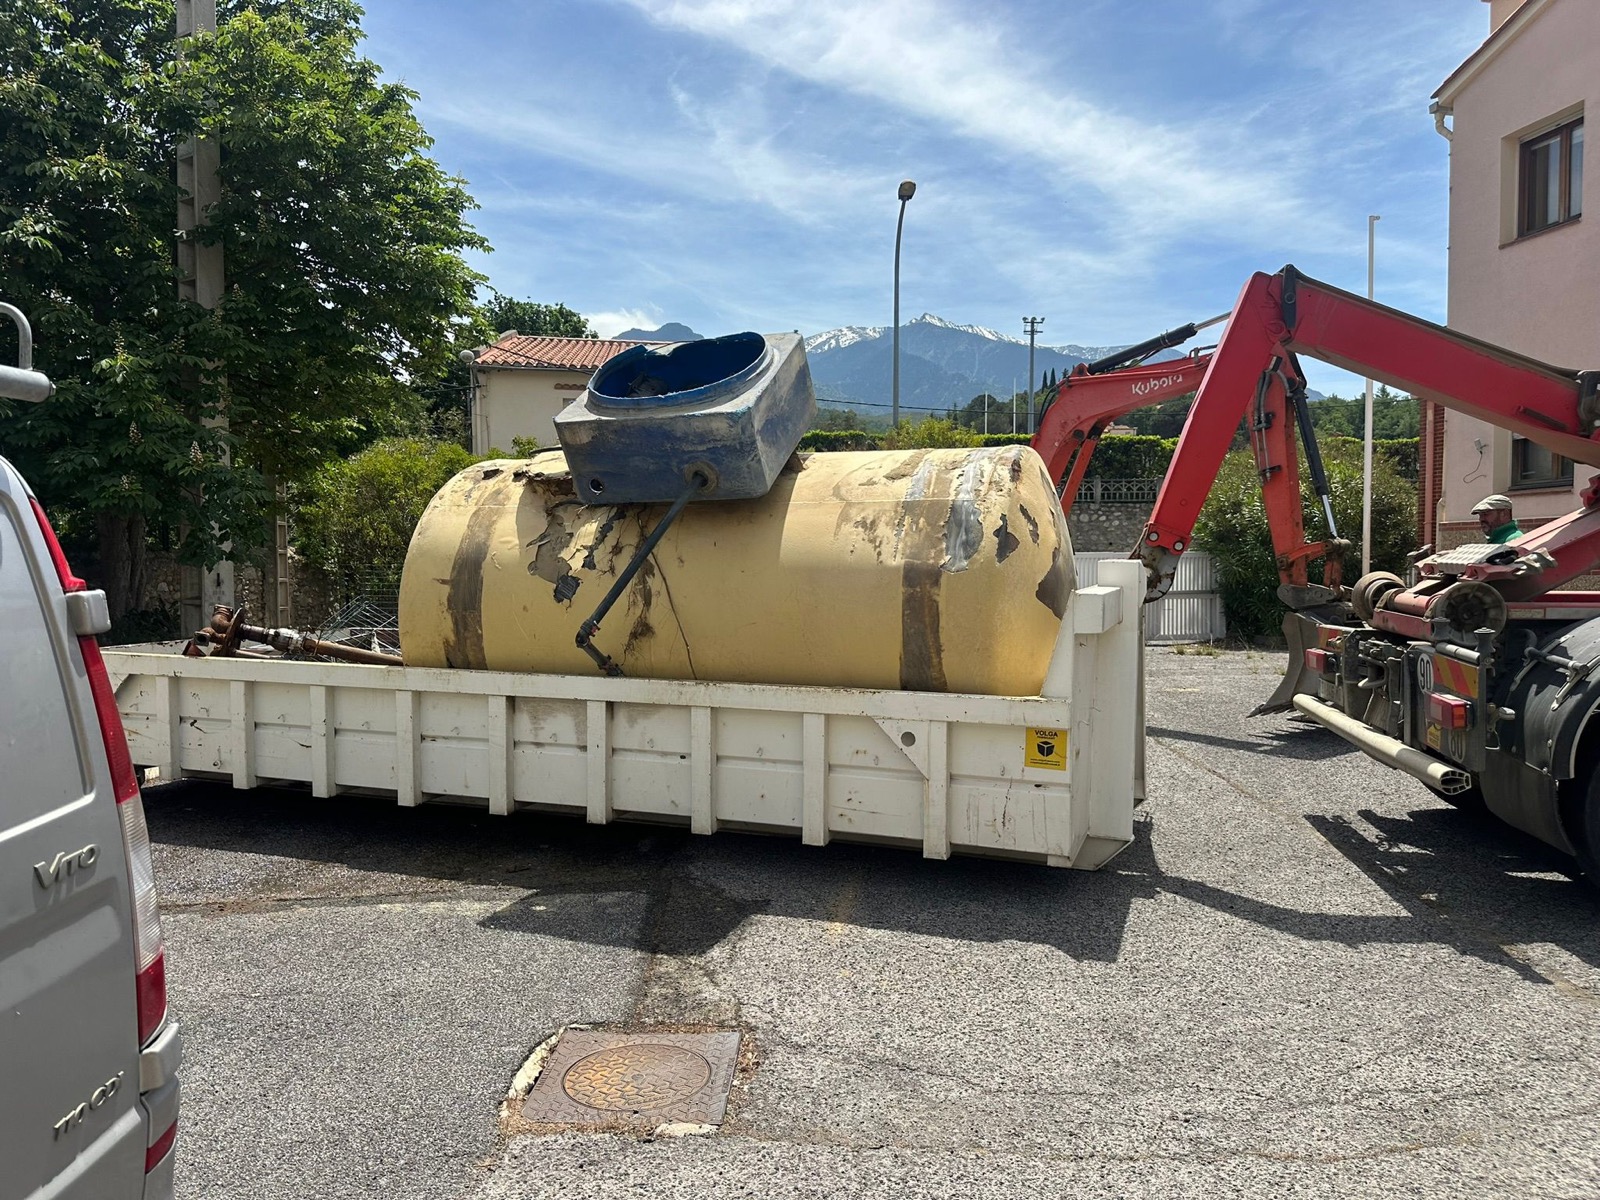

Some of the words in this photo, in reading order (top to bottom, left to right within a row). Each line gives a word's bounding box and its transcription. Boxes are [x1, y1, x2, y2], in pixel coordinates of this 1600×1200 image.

[1132, 373, 1183, 396] Kubota
[1420, 657, 1431, 690] 90
[1034, 729, 1058, 738] VOLGA
